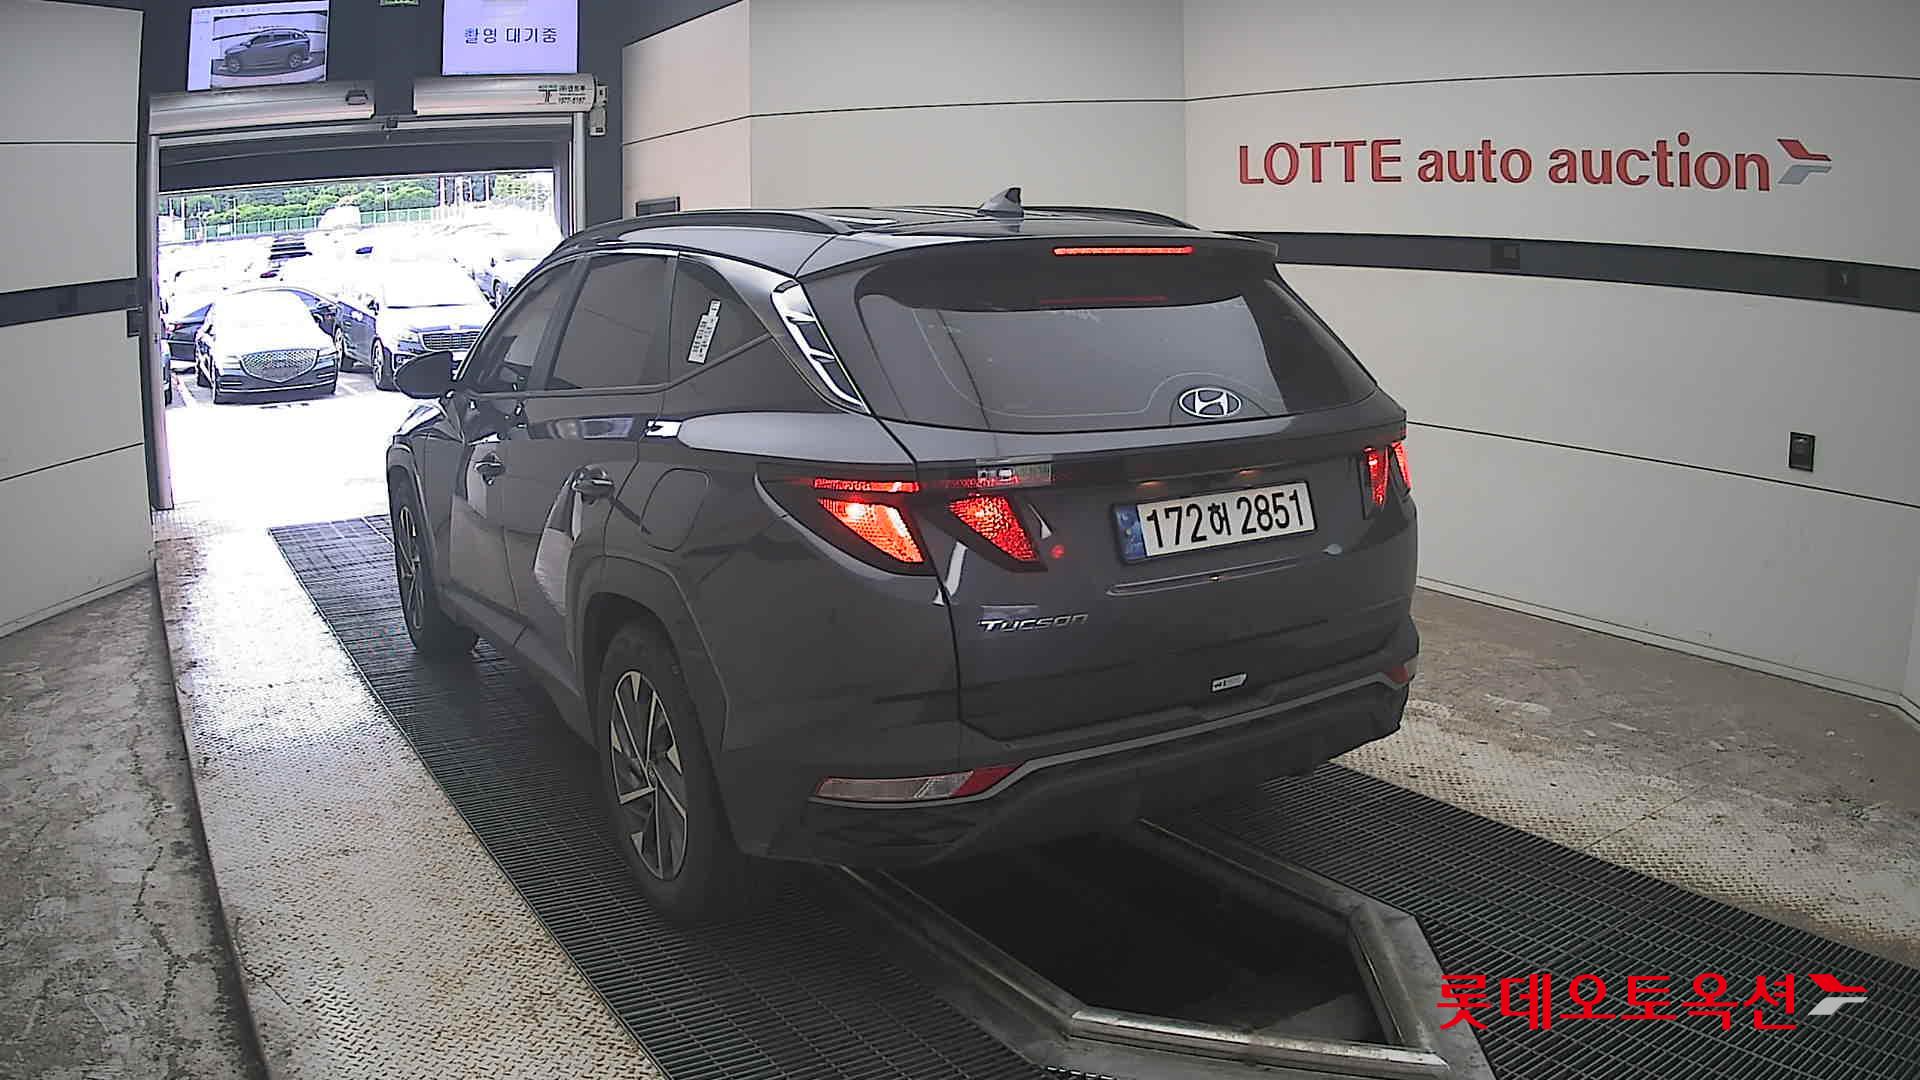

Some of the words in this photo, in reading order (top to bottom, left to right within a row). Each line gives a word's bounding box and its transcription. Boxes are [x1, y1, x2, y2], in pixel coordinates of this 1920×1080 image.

[505, 27, 557, 43] 대기중
[1239, 138, 1402, 185] LOTTE
[1417, 139, 1533, 184] auto
[1548, 132, 1771, 191] auction
[1146, 502, 1232, 548] 172허
[1236, 489, 1304, 535] 2851
[978, 613, 1088, 633] TUCSON
